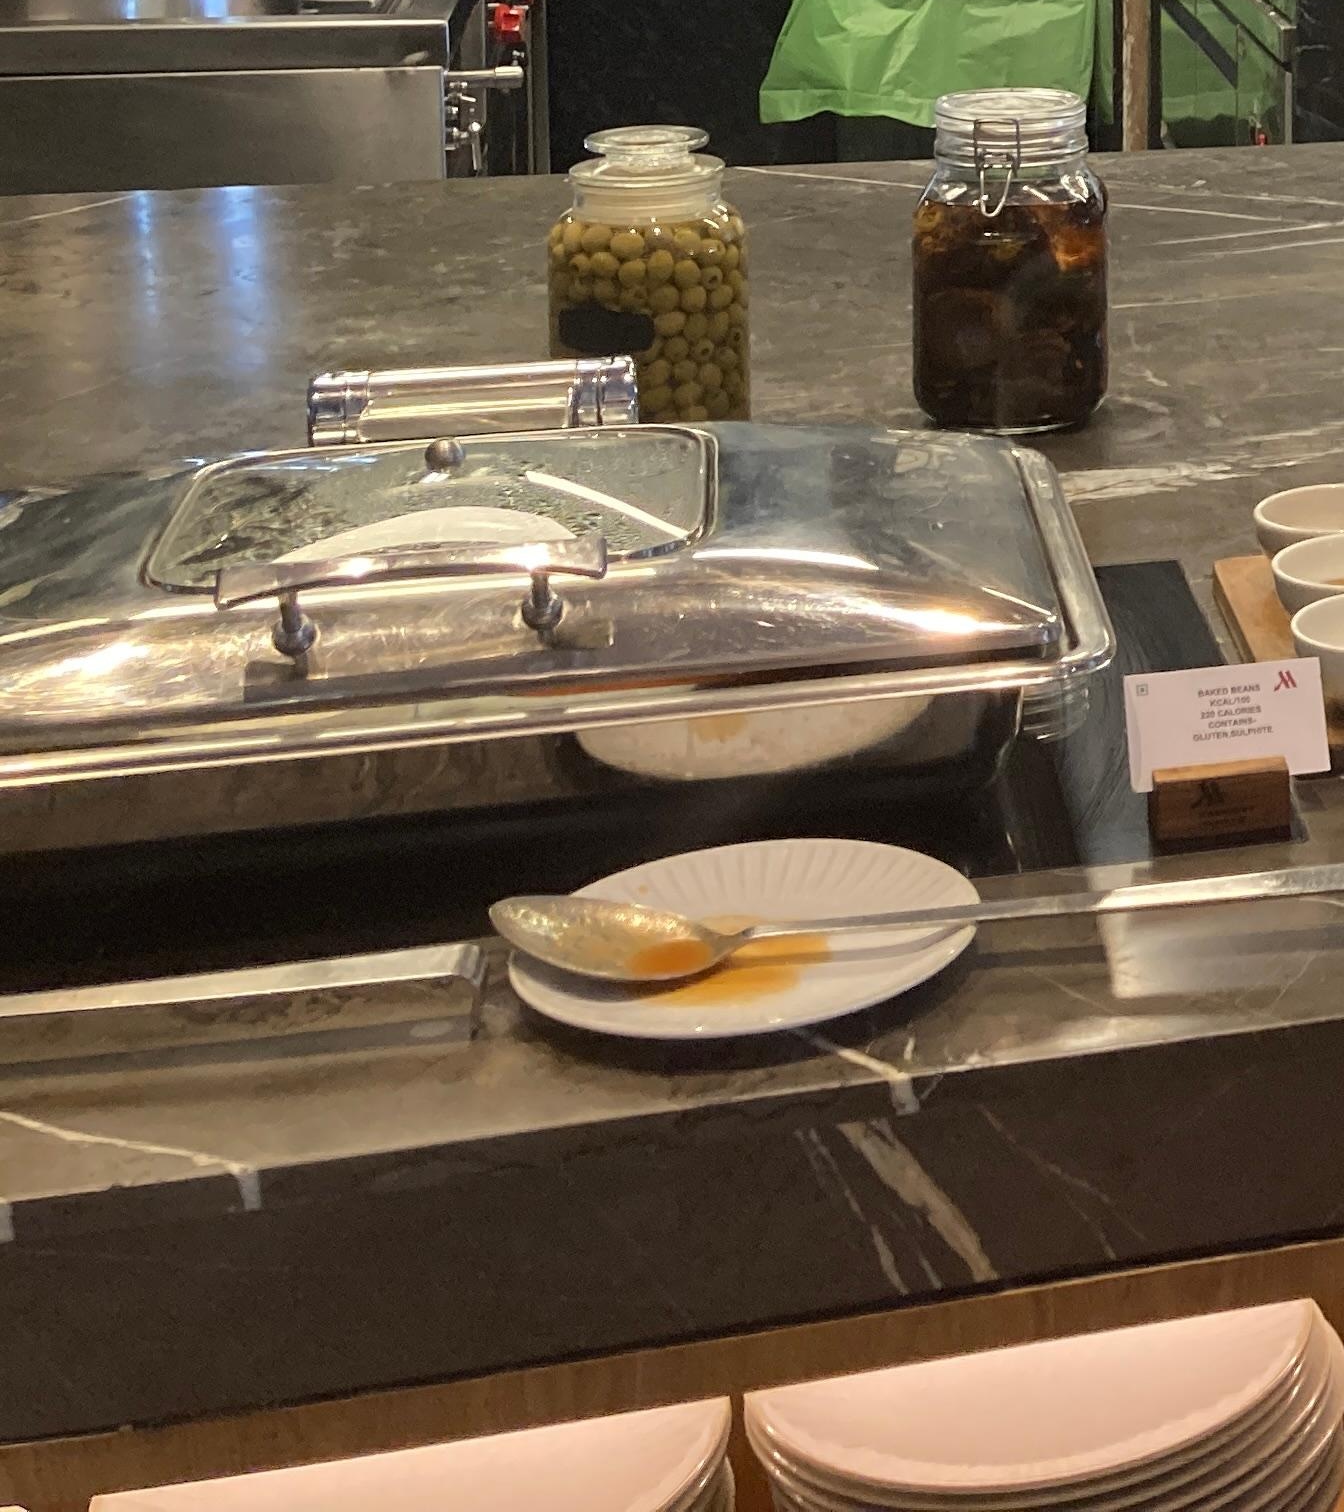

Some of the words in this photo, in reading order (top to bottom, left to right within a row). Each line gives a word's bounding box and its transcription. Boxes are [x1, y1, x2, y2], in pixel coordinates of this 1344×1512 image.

[1197, 687, 1229, 698] BAKED
[1230, 683, 1261, 694] BEANS
[1217, 705, 1262, 717] CALORIES
